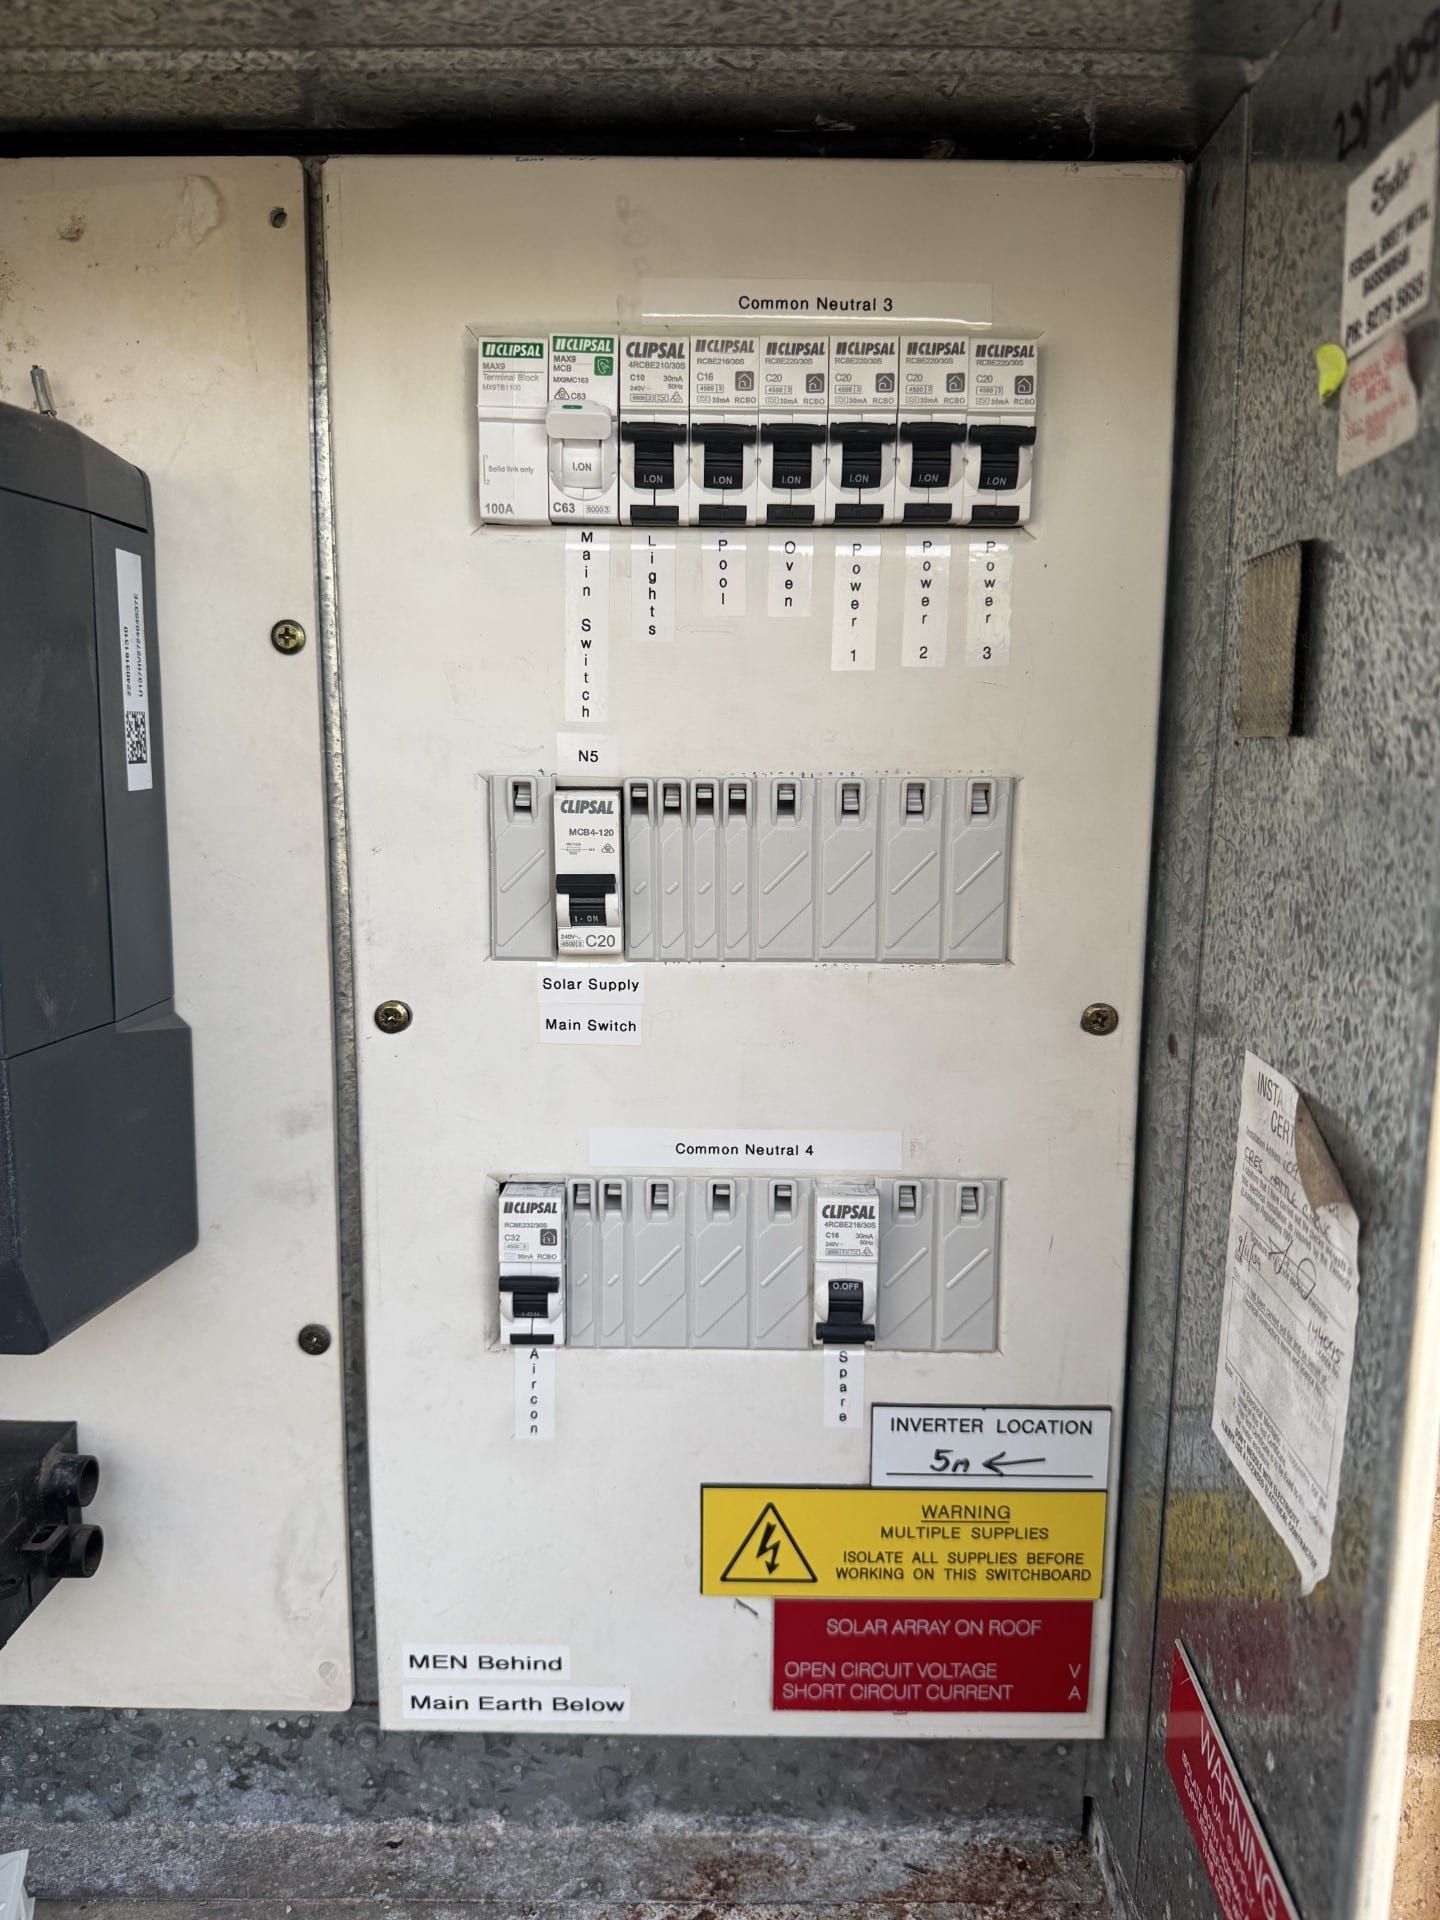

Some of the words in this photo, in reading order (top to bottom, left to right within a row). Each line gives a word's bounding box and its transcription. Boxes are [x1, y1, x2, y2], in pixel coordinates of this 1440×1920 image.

[738, 296, 809, 310] Common
[817, 297, 876, 311] Neutral
[883, 298, 893, 312] 3
[497, 344, 540, 357] CLIPSAL
[567, 338, 611, 351] CLIPSAL
[626, 342, 685, 358] CLIPSAL
[708, 340, 754, 353] CLIPSAL
[778, 342, 825, 355] CLIPSAL
[848, 342, 895, 355] CLIPSAL
[919, 342, 965, 355] CLIPSAL
[988, 345, 1034, 357] CLIPSAL
[554, 355, 576, 363] MAX9
[697, 373, 713, 381] C16
[766, 374, 782, 382] C20
[976, 375, 993, 383] C20
[485, 504, 513, 514] 100A
[553, 503, 575, 513] C63
[581, 532, 593, 597] Main
[718, 540, 728, 605] Pool
[784, 542, 796, 607] Oven
[647, 536, 657, 635] Lights
[850, 544, 862, 627] Power
[920, 541, 932, 624] Power
[985, 542, 996, 624] Power
[850, 650, 856, 662] 1
[919, 647, 928, 660] 2
[982, 647, 992, 660] 3
[580, 619, 592, 718] Switch
[578, 750, 599, 762] N5
[560, 800, 613, 814] CLIPSAL
[586, 935, 615, 947] C20
[543, 978, 581, 990] Solar
[588, 979, 639, 992] Supply
[545, 1019, 581, 1030] Main
[588, 1020, 637, 1032] Switch
[675, 1142, 738, 1156] Common
[745, 1143, 799, 1156] Neutral
[805, 1145, 814, 1156] 4
[514, 1202, 557, 1213] CLIPSAL
[822, 1205, 875, 1219] CLIPSAL
[529, 1349, 539, 1434] Aircon
[839, 1351, 848, 1422] Spare
[890, 1418, 983, 1434] INVERTER
[996, 1419, 1093, 1435] LOCATION
[921, 1505, 1011, 1520] WARNING
[880, 1526, 961, 1539] MULTIPLE
[971, 1527, 1049, 1540] SUPPLIES
[843, 1551, 903, 1564] ISOLATE
[912, 1551, 938, 1564] ALL
[947, 1551, 1017, 1565] SUPPLIES
[1027, 1552, 1084, 1565] BEFORE
[835, 1567, 904, 1580] WORKING
[913, 1568, 934, 1581] ON
[944, 1568, 976, 1581] THIS
[986, 1568, 1092, 1582] SWITCHBOARD
[826, 1619, 887, 1635] SOLAR
[891, 1619, 949, 1635] ARRAY
[955, 1620, 983, 1635] ON
[988, 1620, 1043, 1636] ROOF
[409, 1654, 468, 1669] MEN
[479, 1656, 562, 1671] Behind
[784, 1662, 835, 1677] OPEN
[840, 1662, 913, 1678] CIRCUIT
[918, 1663, 998, 1679] VOLTAGE
[1069, 1665, 1081, 1678] V
[782, 1684, 845, 1700] SHORT
[849, 1684, 921, 1700] CIRCUIT
[926, 1685, 1014, 1700] CURRENT
[1068, 1686, 1081, 1700] A
[410, 1695, 469, 1710] Main
[479, 1696, 542, 1711] Earth
[553, 1697, 624, 1712] Below
[1200, 1716, 1278, 1919] WARNING
